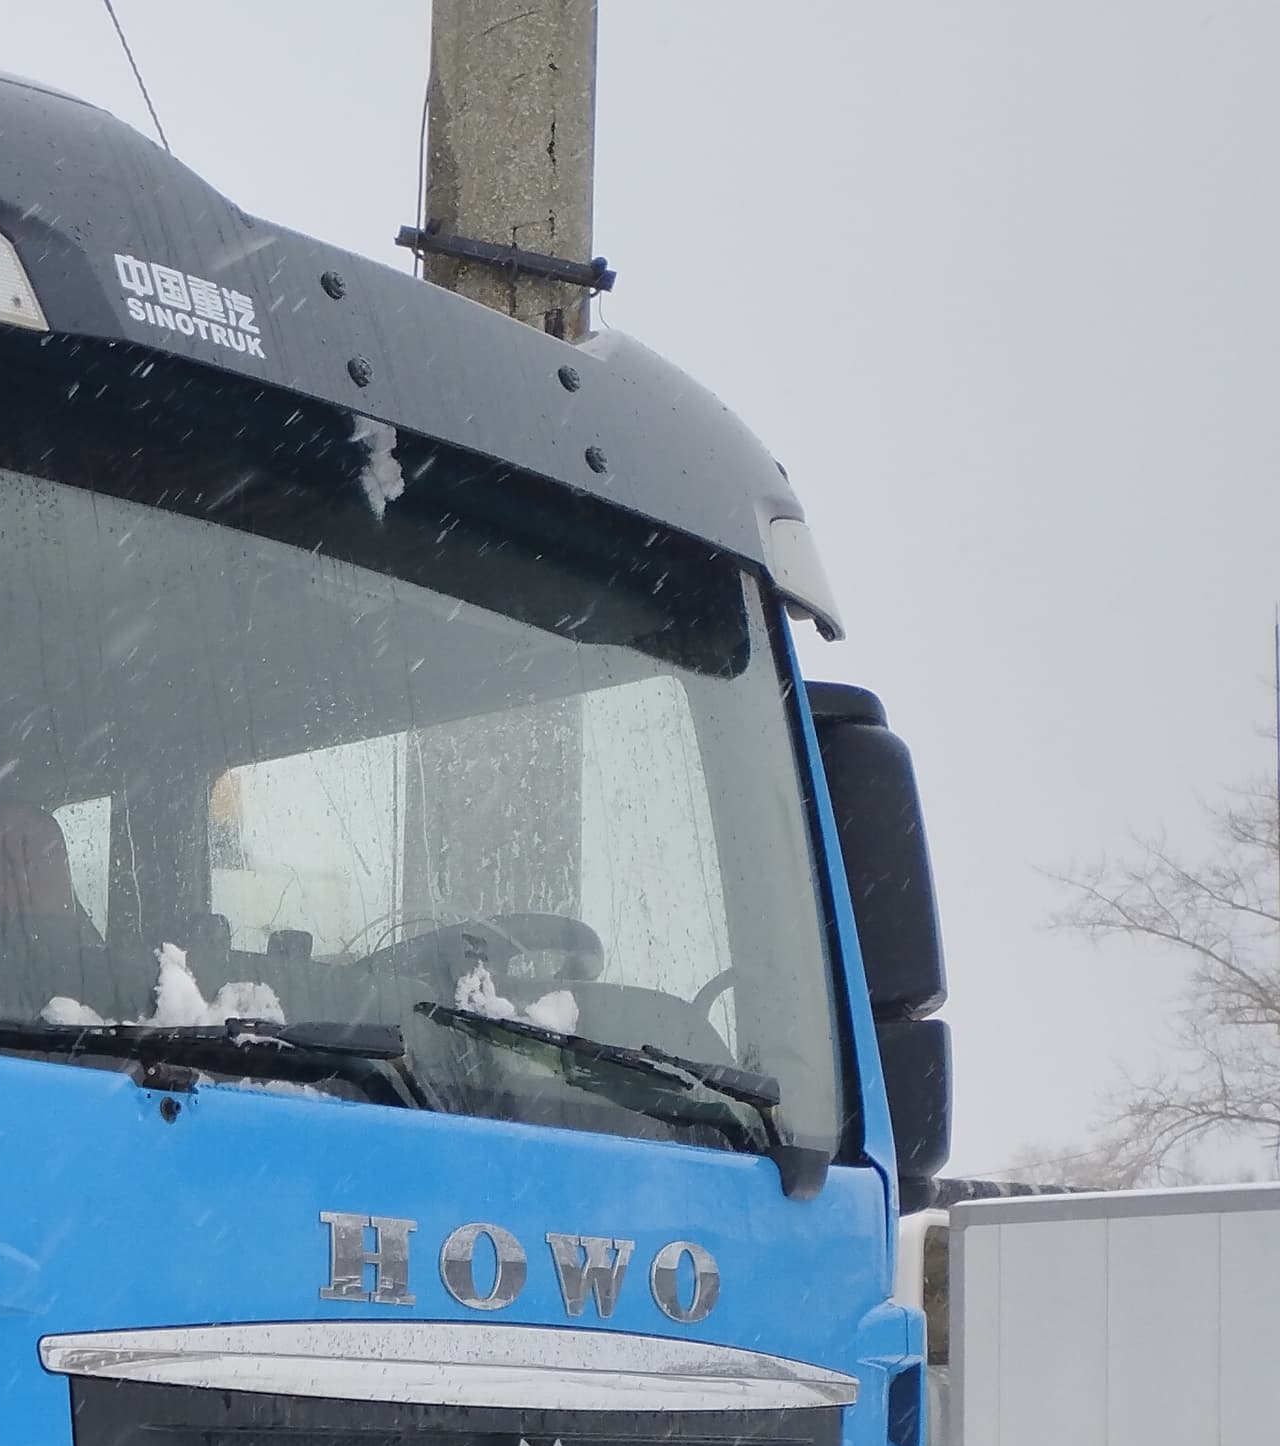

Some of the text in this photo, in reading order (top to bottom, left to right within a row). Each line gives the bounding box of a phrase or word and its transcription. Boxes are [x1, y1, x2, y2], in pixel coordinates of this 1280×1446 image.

[114, 253, 260, 335] 中国重汽
[126, 297, 266, 359] SINOTRUK
[319, 1210, 721, 1324] HOWO
